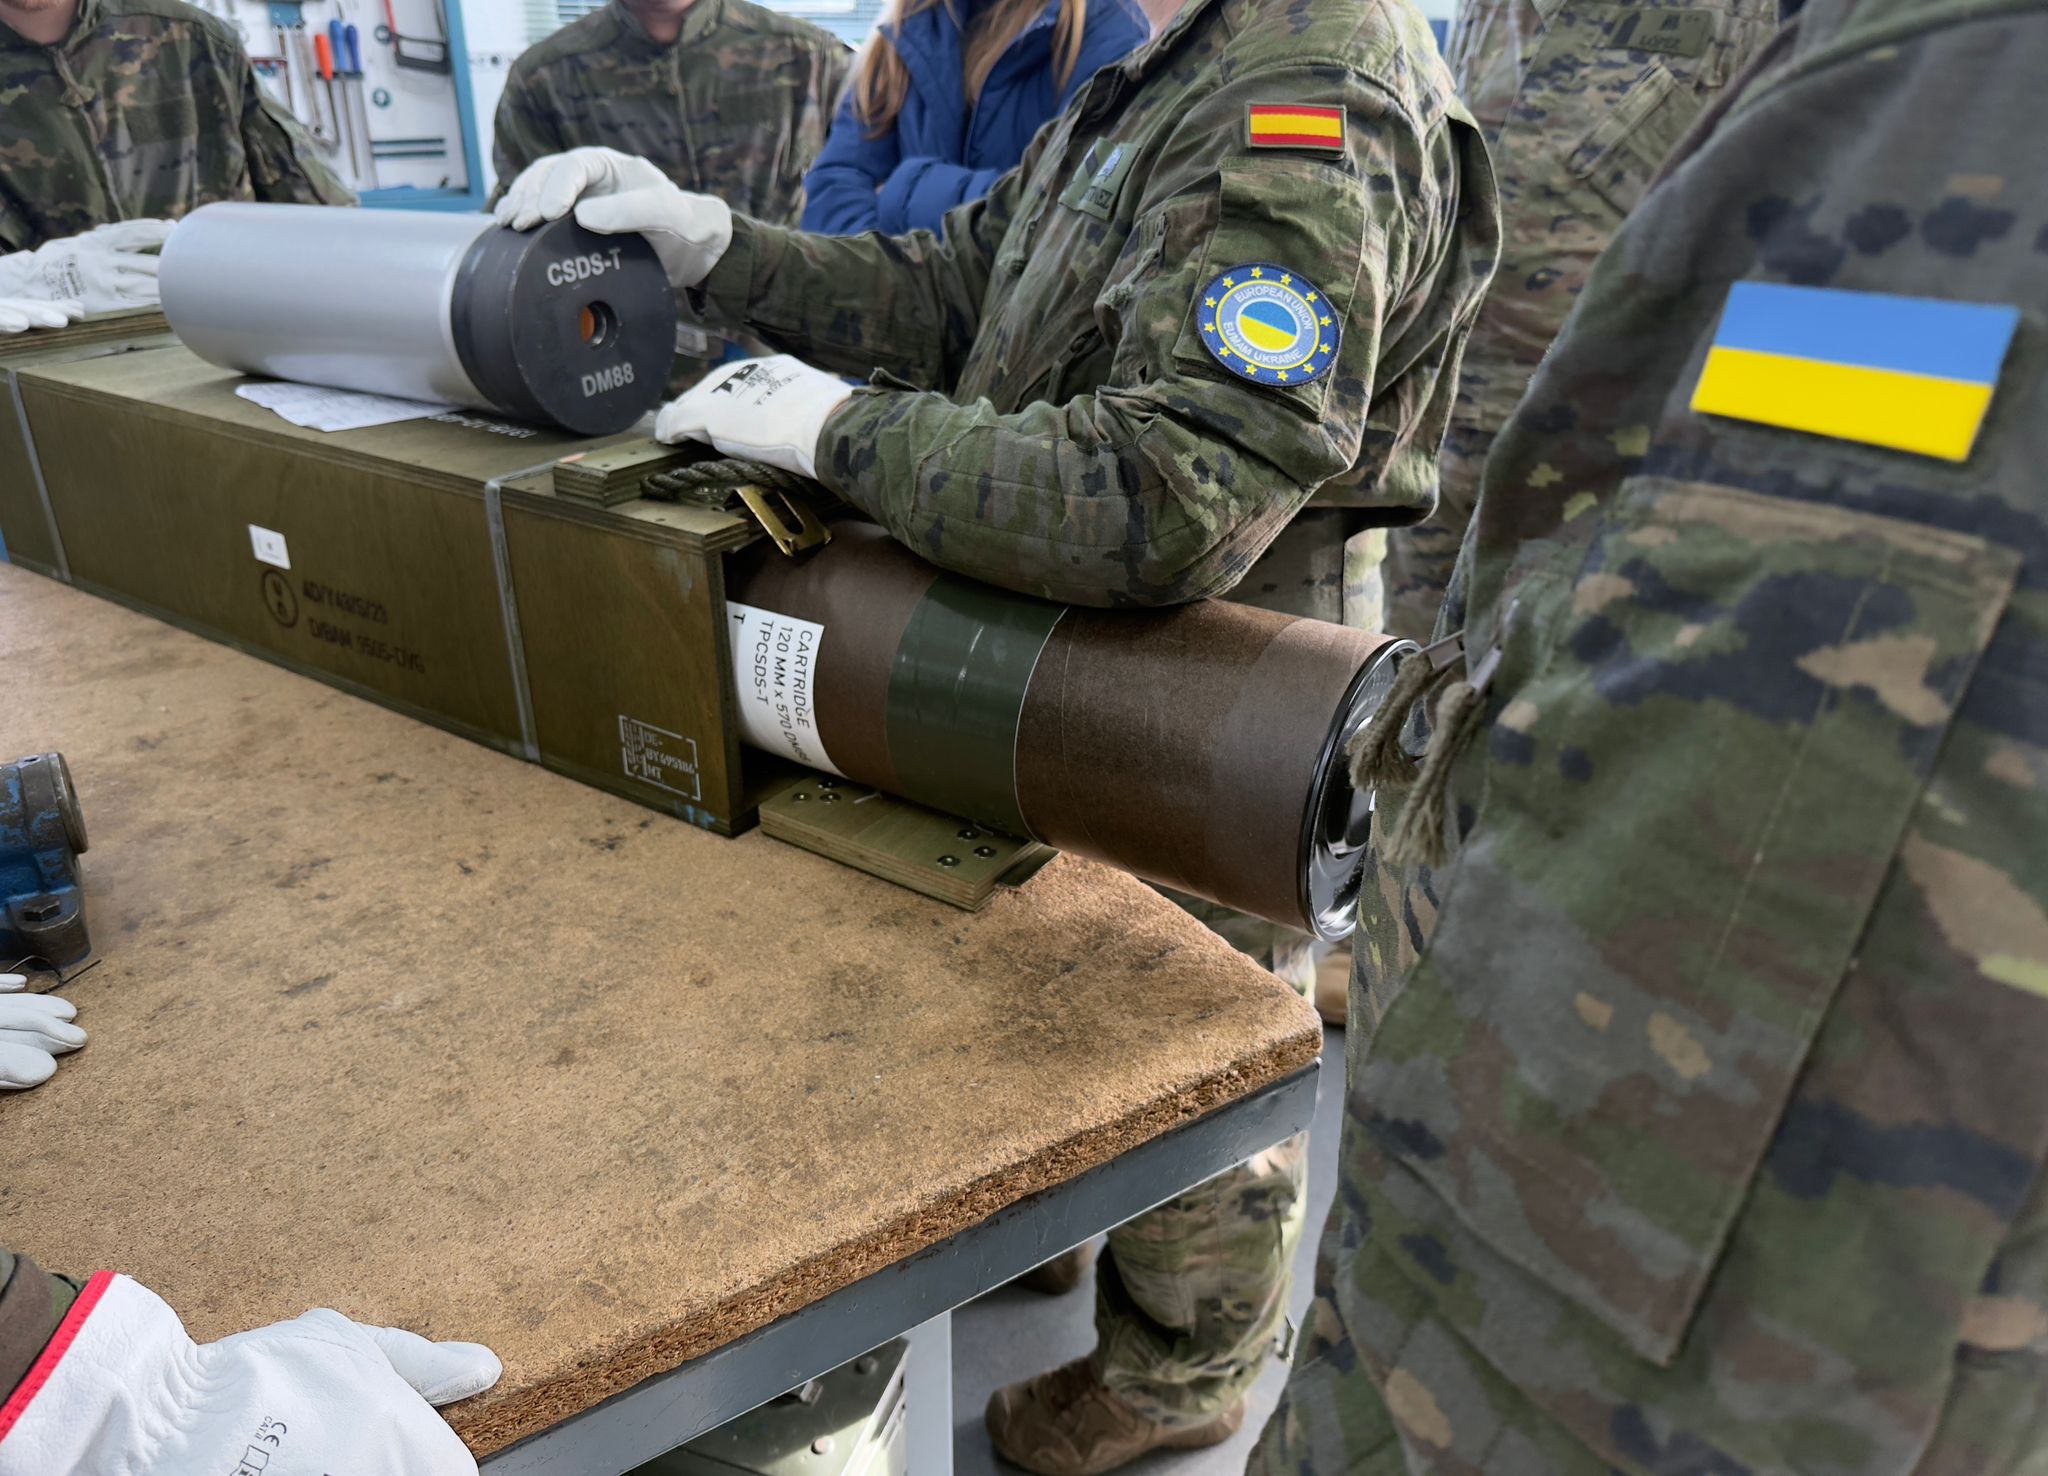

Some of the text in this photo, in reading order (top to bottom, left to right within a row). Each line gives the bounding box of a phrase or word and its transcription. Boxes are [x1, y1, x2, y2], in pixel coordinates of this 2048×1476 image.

[547, 247, 621, 286] CSDS-T
[1233, 285, 1314, 331] EUROPEAN UNION
[1223, 321, 1303, 364] EUMAM UKRAINE
[581, 362, 635, 397] DM88
[733, 613, 746, 625] T
[776, 626, 794, 653] 120
[754, 620, 774, 707] TPCSDS-T
[773, 655, 787, 688] MM
[793, 630, 813, 729] CARTRIDGE
[775, 703, 792, 730] 570
